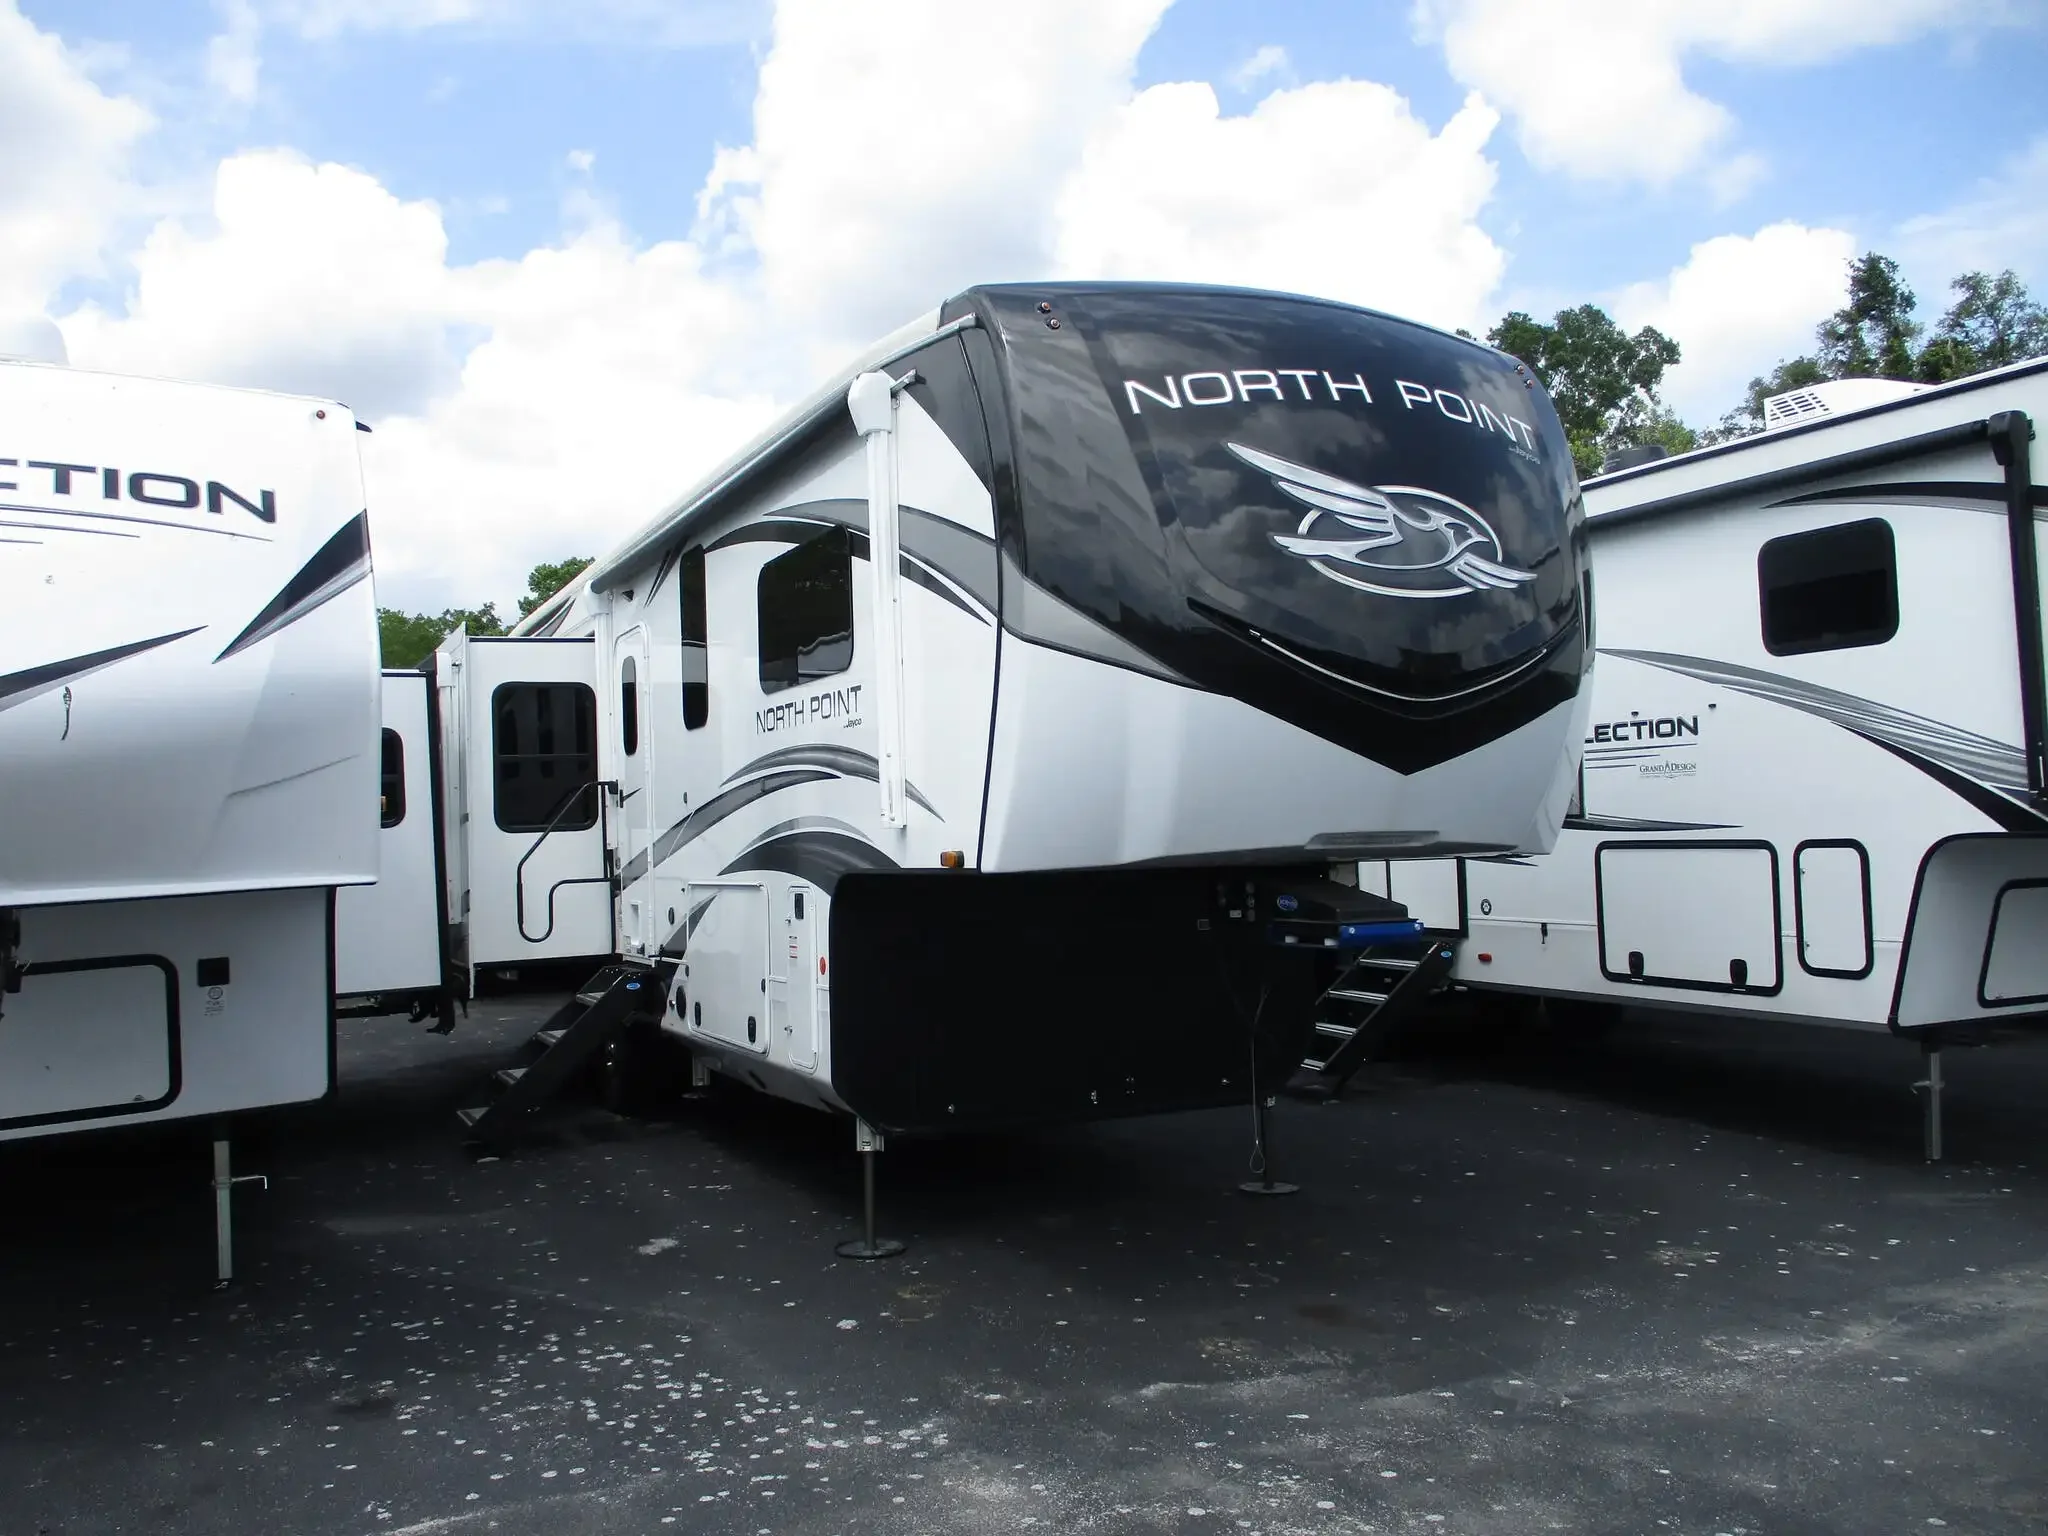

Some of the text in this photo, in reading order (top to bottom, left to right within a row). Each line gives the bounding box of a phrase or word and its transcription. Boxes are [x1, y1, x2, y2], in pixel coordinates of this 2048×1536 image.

[1123, 369, 1533, 450] NORTH POINT
[0, 458, 276, 524] TION
[756, 684, 862, 735] NORTH POINT
[1639, 762, 1697, 773] GRAND DESIGN
